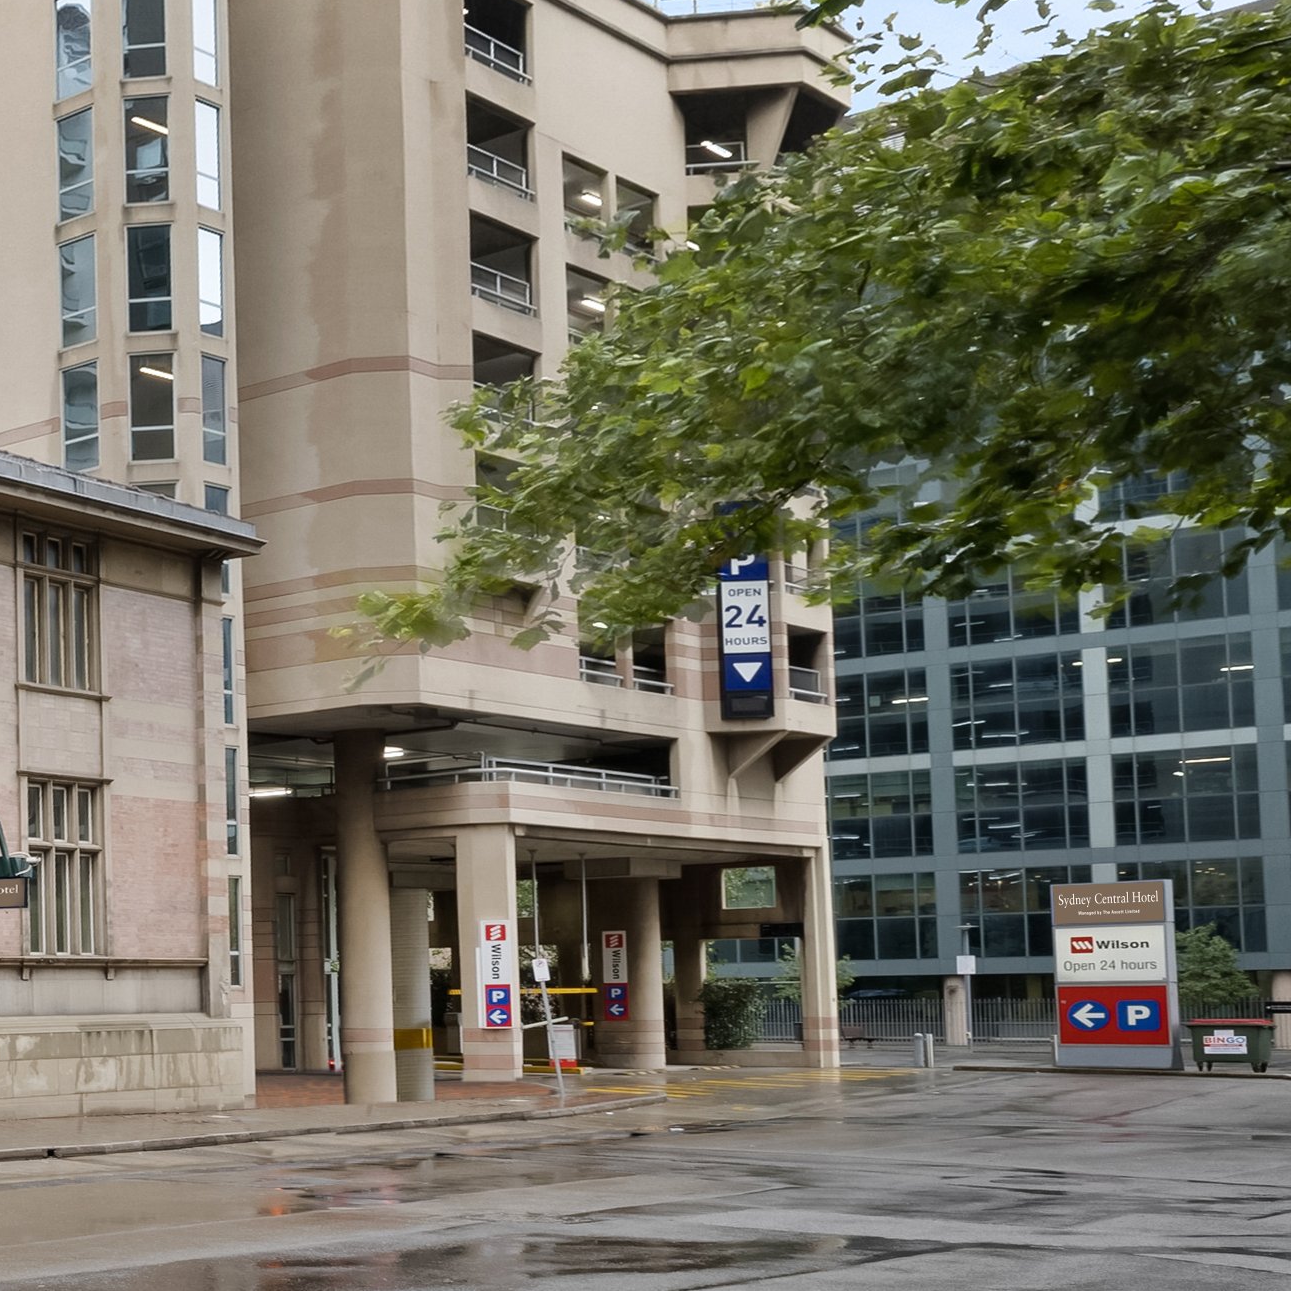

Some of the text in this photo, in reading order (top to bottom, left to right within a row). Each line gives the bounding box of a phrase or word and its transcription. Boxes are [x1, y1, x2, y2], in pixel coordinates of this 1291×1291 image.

[728, 588, 762, 597] OPEN
[724, 604, 767, 629] 24
[725, 636, 768, 646] HOURS
[1058, 890, 1159, 908] Sydney Central Hotel
[1096, 940, 1150, 949] Wilson
[491, 944, 502, 979] Wilson
[611, 949, 621, 979] Wilson
[1063, 960, 1158, 973] Open 24 hours
[492, 990, 505, 1002] P
[611, 988, 622, 998] P
[1127, 1005, 1151, 1026] P
